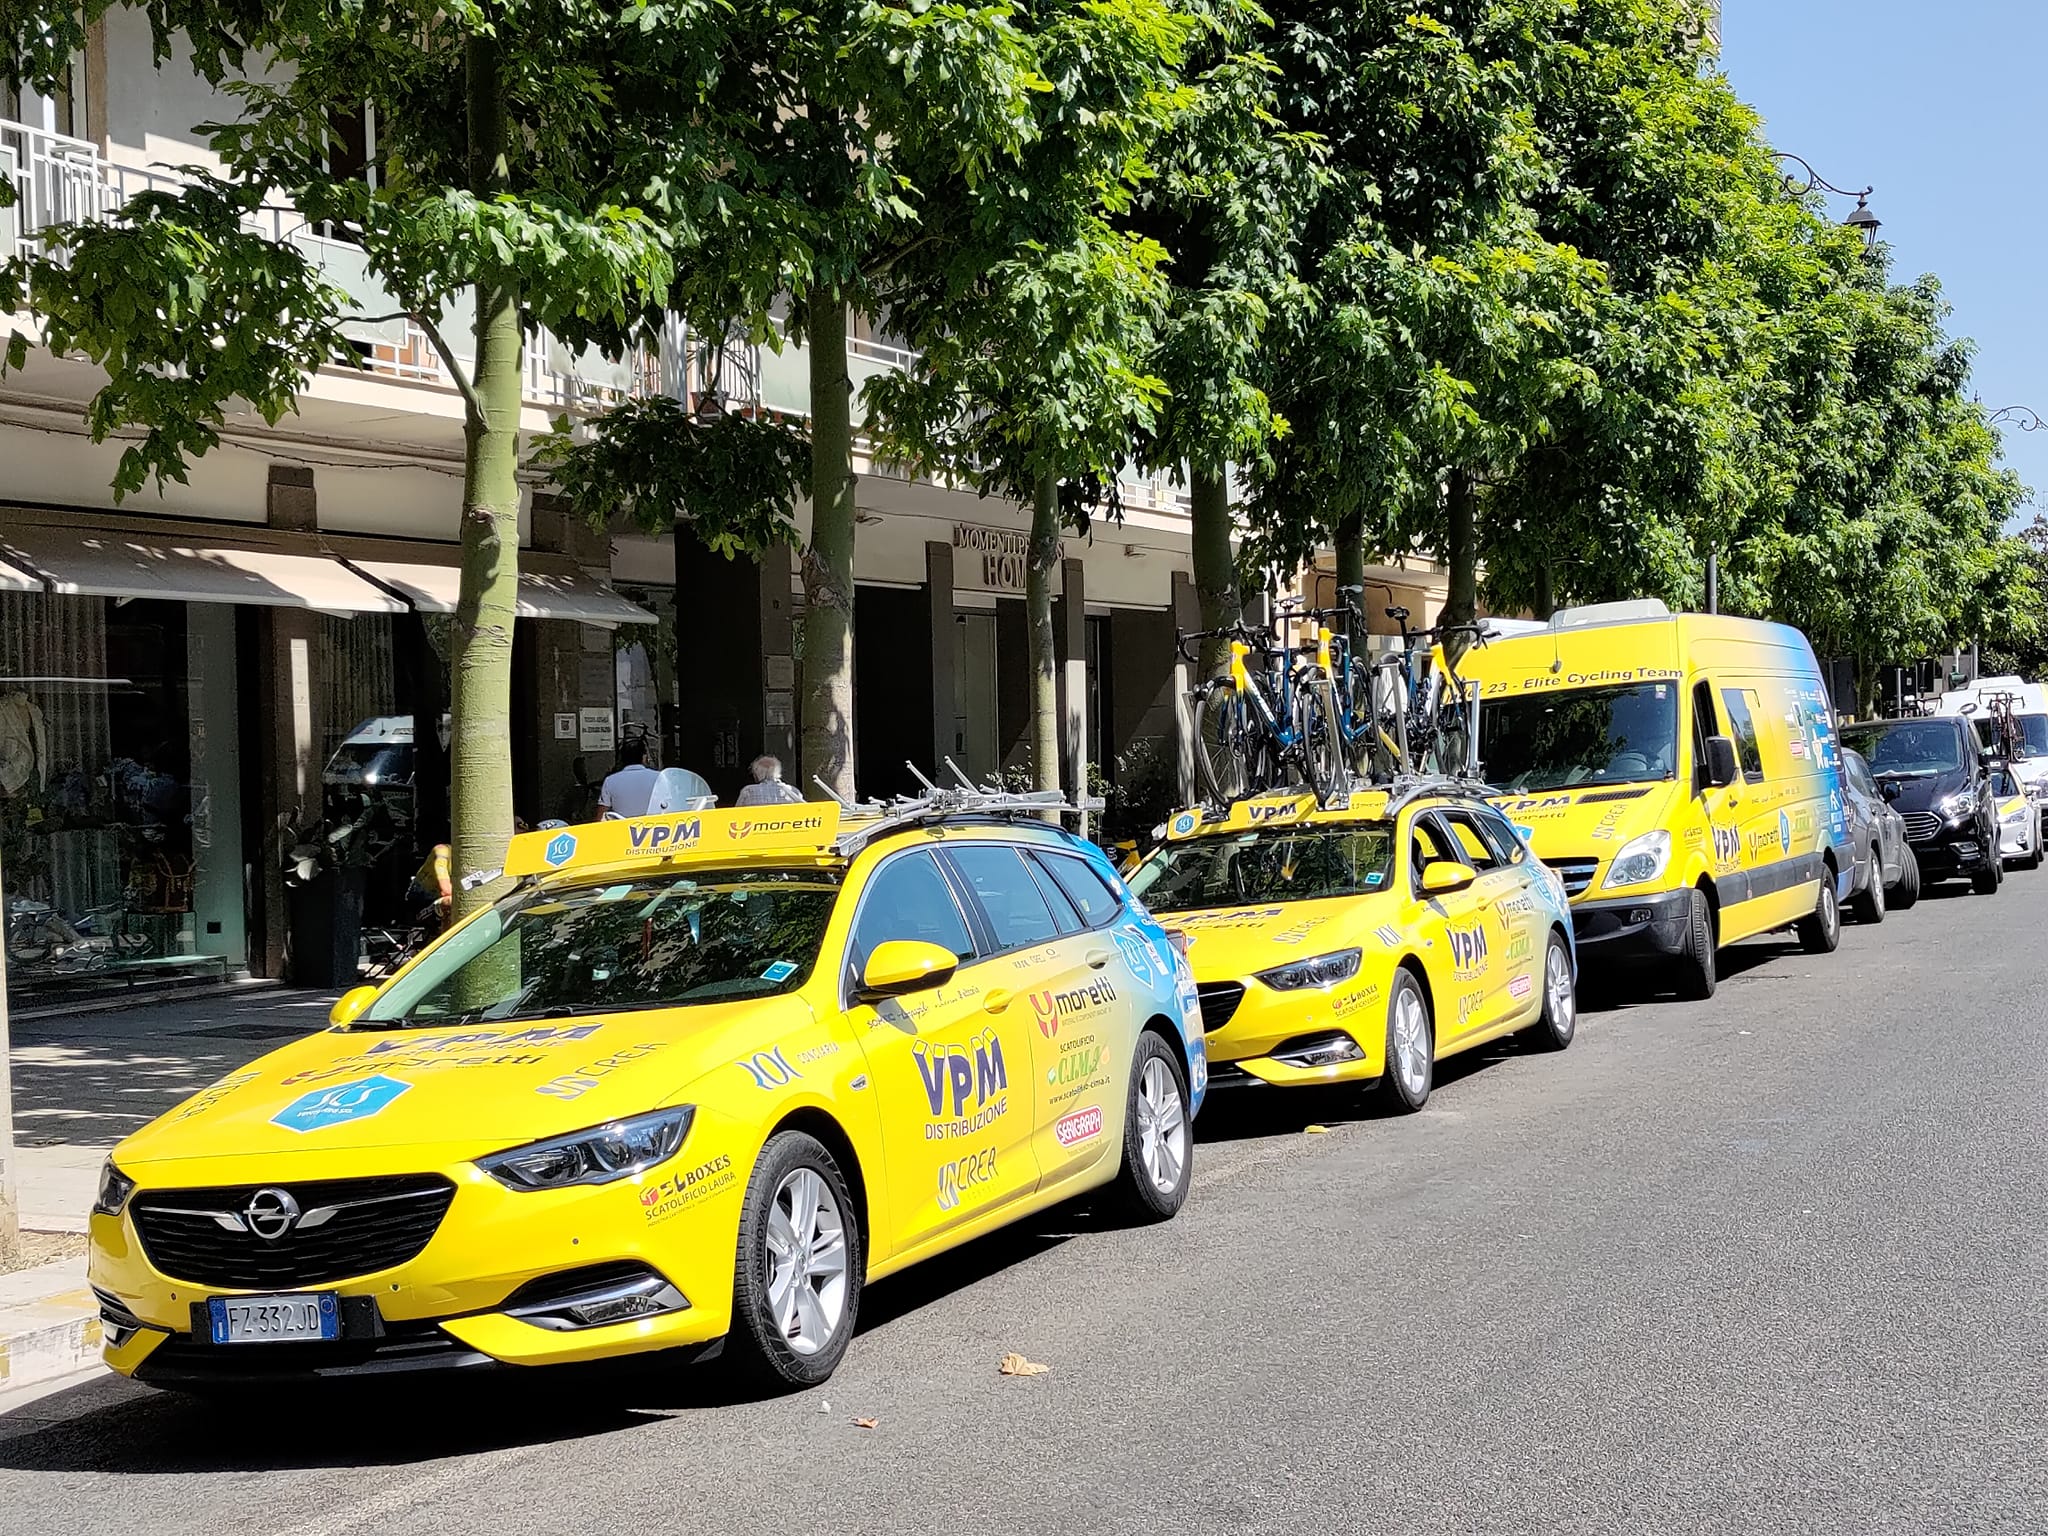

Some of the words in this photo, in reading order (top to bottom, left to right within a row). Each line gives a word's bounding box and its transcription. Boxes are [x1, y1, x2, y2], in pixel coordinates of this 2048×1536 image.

[985, 553, 1028, 588] HOM
[1487, 682, 1508, 694] 23
[1523, 676, 1561, 690] Elite
[1567, 669, 1633, 685] Cycling
[1636, 667, 1683, 678] Team
[753, 816, 822, 831] moretti
[1249, 801, 1297, 819] VPM
[625, 840, 698, 856] DISTRIBUZIONE
[629, 815, 701, 848] VPM
[1445, 916, 1488, 969] VPM
[1055, 976, 1117, 1016] moretti
[350, 1054, 549, 1072] moretti
[912, 1027, 1007, 1117] VPM
[925, 1096, 1008, 1140] DISTRIBUZIONE
[1056, 1110, 1101, 1143] SERIGRAPH
[645, 1186, 708, 1221] SCATOLIFICIO
[709, 1171, 737, 1191] LAURA
